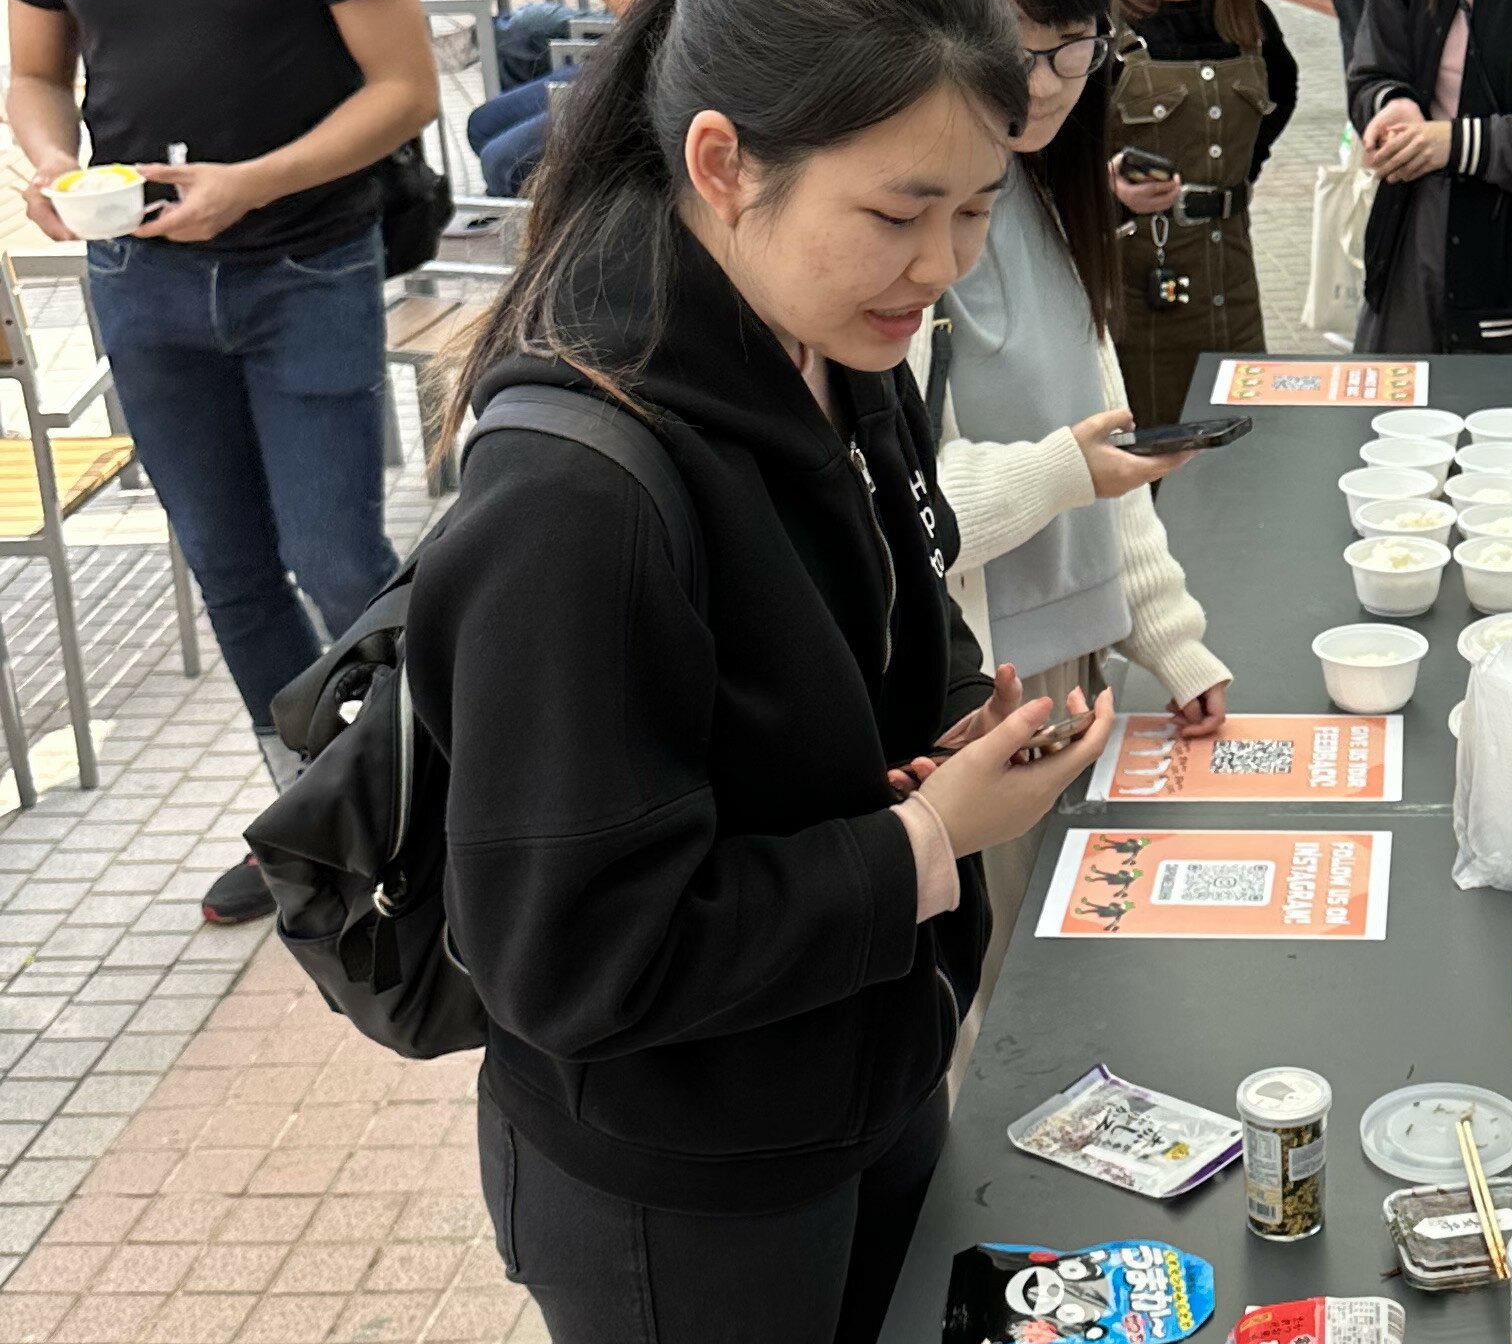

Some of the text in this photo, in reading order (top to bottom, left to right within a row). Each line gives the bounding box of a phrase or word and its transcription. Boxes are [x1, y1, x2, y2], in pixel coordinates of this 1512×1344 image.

[1349, 725, 1370, 747] GIVE
[1346, 762, 1368, 788] YOUR
[1282, 841, 1320, 925] INSTAGRAM!
[1325, 840, 1356, 925] FOLLOW US ON
